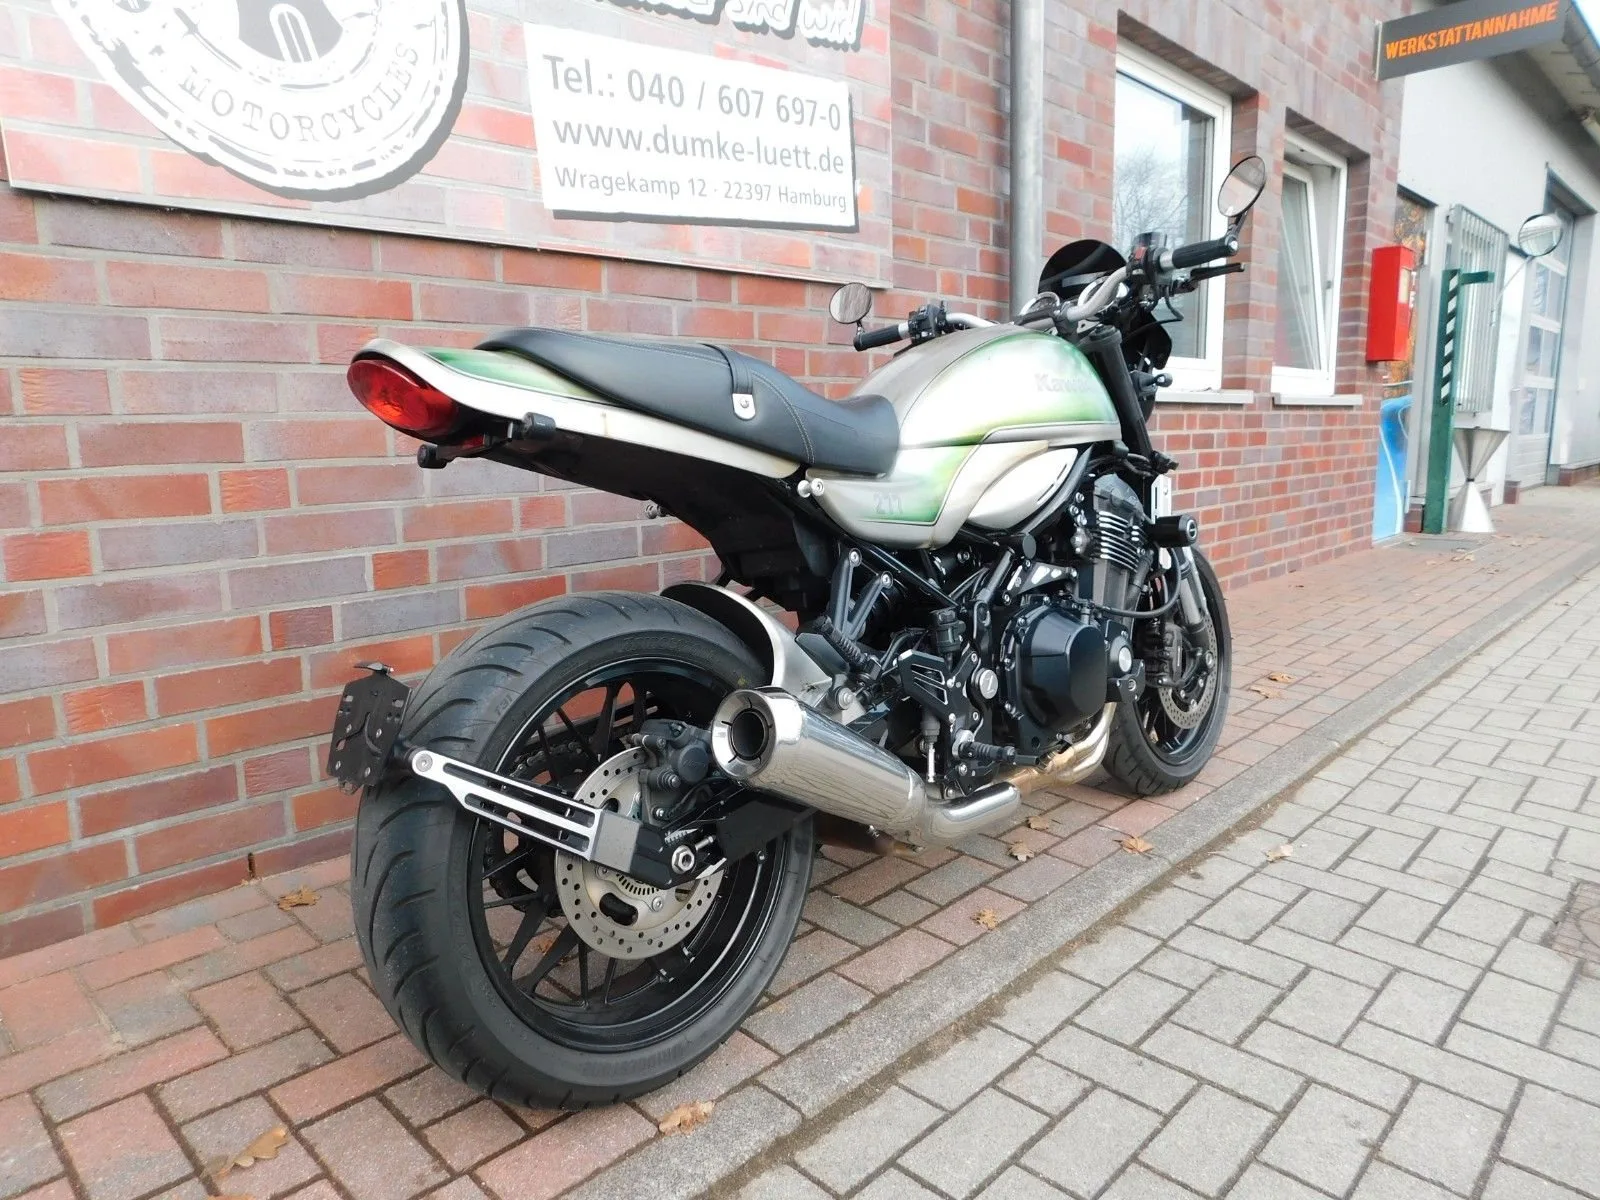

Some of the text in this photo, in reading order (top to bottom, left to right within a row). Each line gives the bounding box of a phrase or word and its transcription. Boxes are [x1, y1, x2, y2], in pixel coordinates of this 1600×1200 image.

[1386, 1, 1559, 59] WERKSTATTANNAHME
[178, 42, 419, 142] MOTORCYCLES
[543, 54, 841, 131] Tel.: 040 / 607 697-0
[552, 119, 844, 173] www.dumke-luett.de
[554, 166, 680, 200] Wragekamp
[688, 178, 707, 198] 12
[724, 181, 770, 202] 22397
[778, 186, 847, 213] Hamburg
